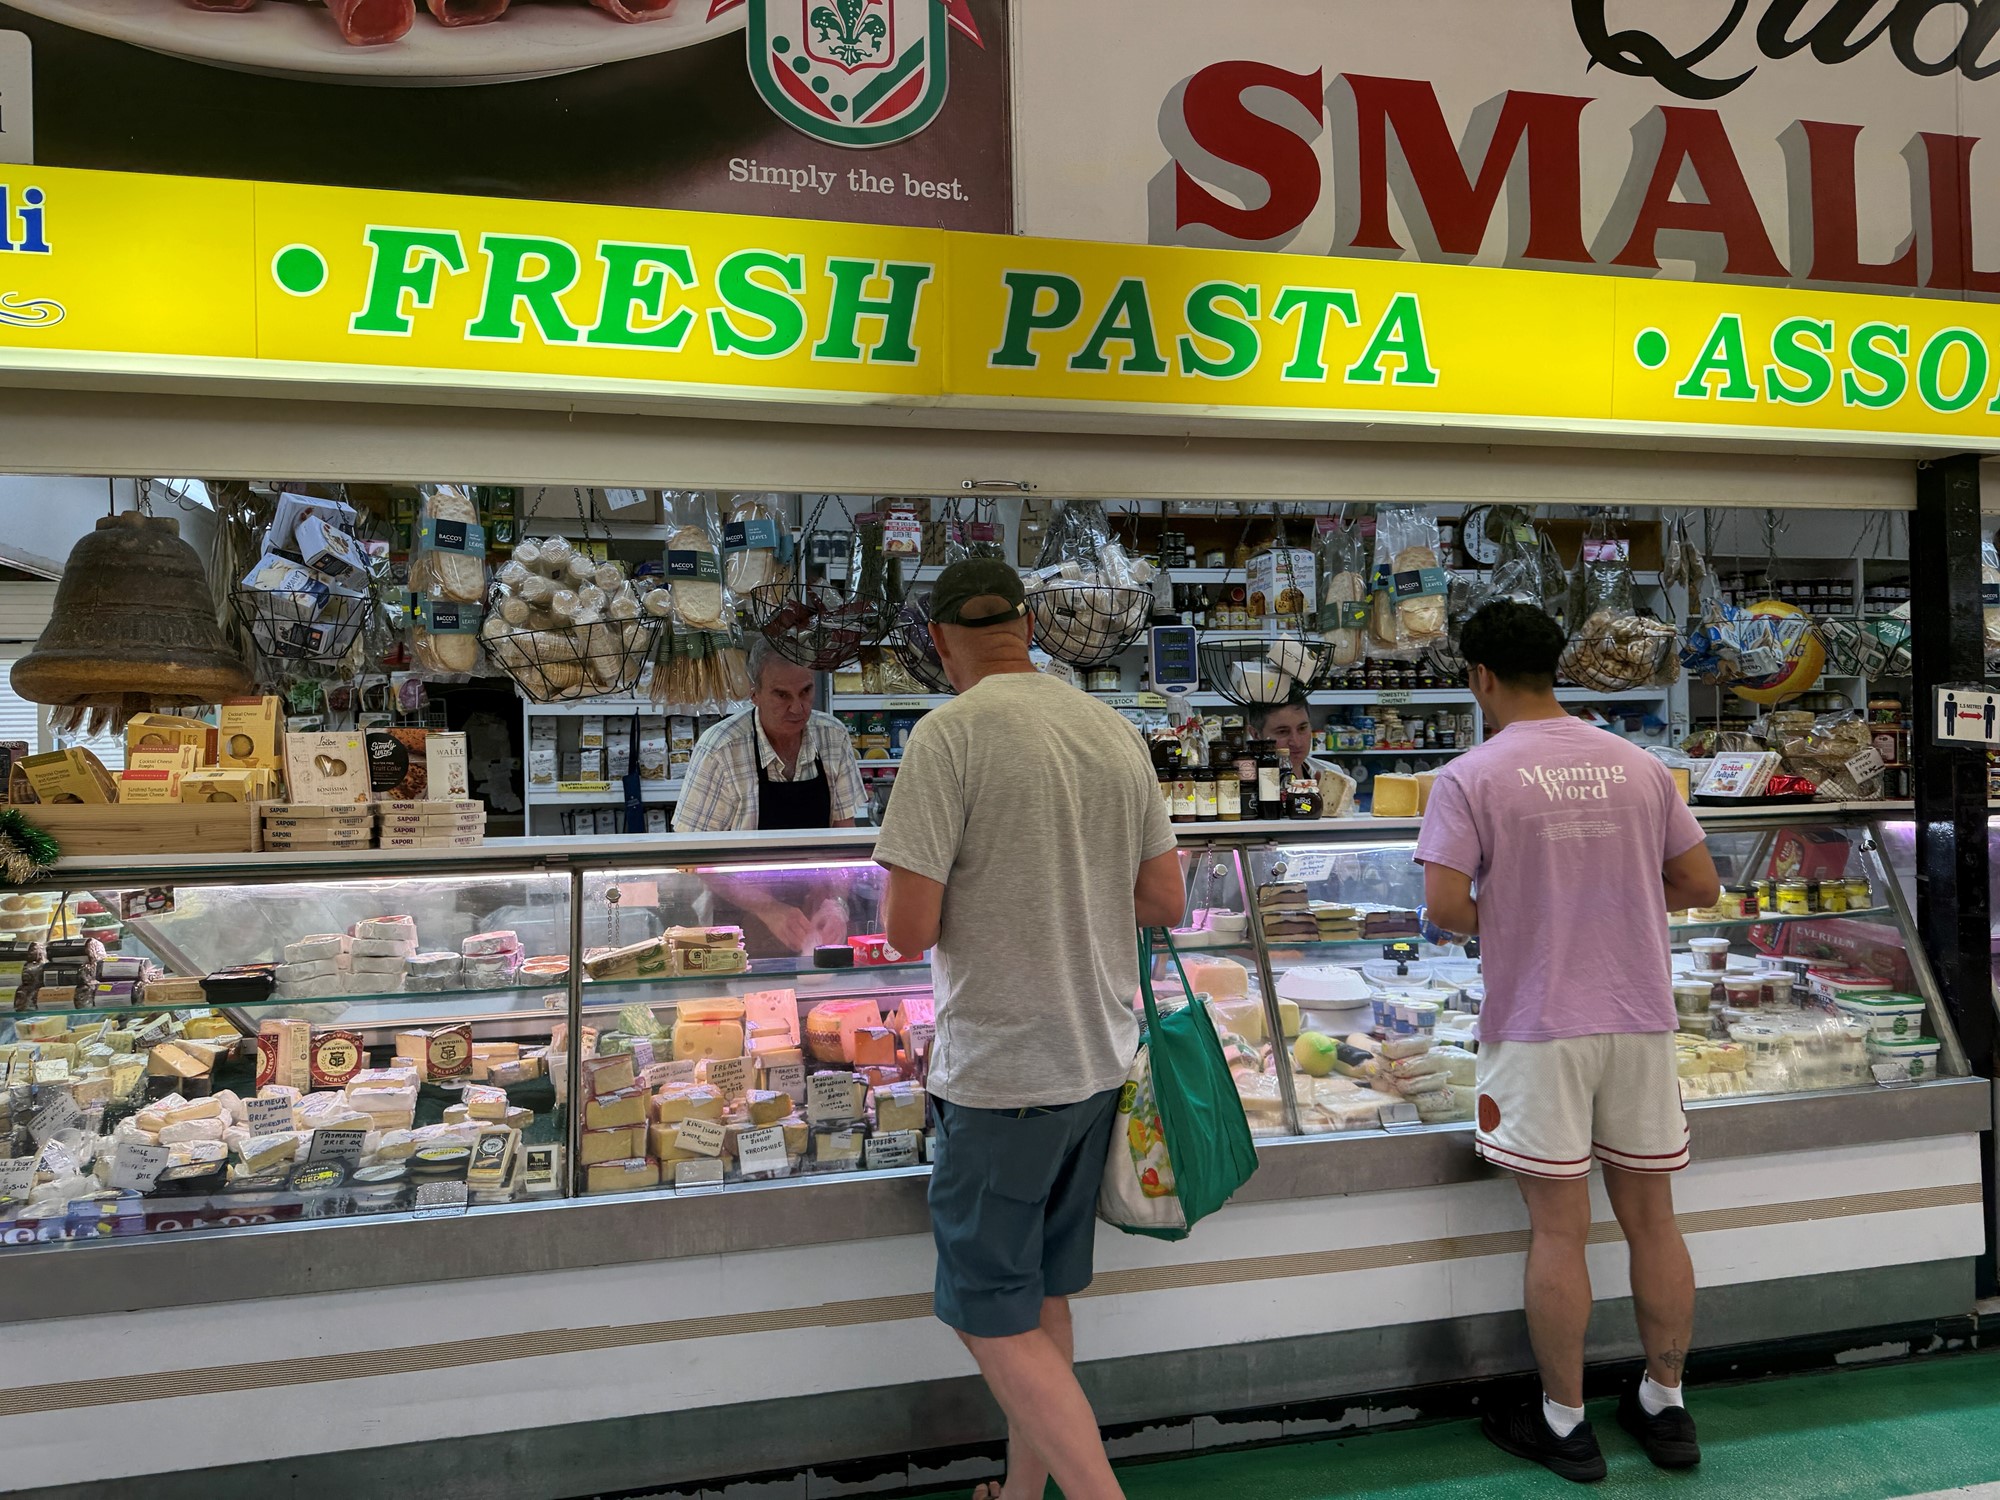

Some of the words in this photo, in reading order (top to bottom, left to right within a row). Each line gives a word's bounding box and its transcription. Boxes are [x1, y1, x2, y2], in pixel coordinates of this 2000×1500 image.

[728, 157, 837, 195] Simply
[847, 168, 895, 197] the
[904, 172, 970, 202] best.
[348, 224, 936, 367] FRESH
[988, 268, 1440, 389] PASTA
[868, 724, 886, 733] Gallo
[1517, 761, 1627, 787] Meaning
[1540, 779, 1609, 802] Word
[1796, 926, 1858, 949] EVERFILM
[265, 1050, 275, 1074] MERLOT
[713, 1060, 742, 1072] FRENCH
[433, 1065, 465, 1074] BALSAMIC
[324, 1074, 350, 1082] MERLOT
[247, 1097, 287, 1108] CREMEUX
[249, 1113, 268, 1121] BRIE
[686, 1120, 702, 1129] KING
[741, 1128, 774, 1141] CROPWELL
